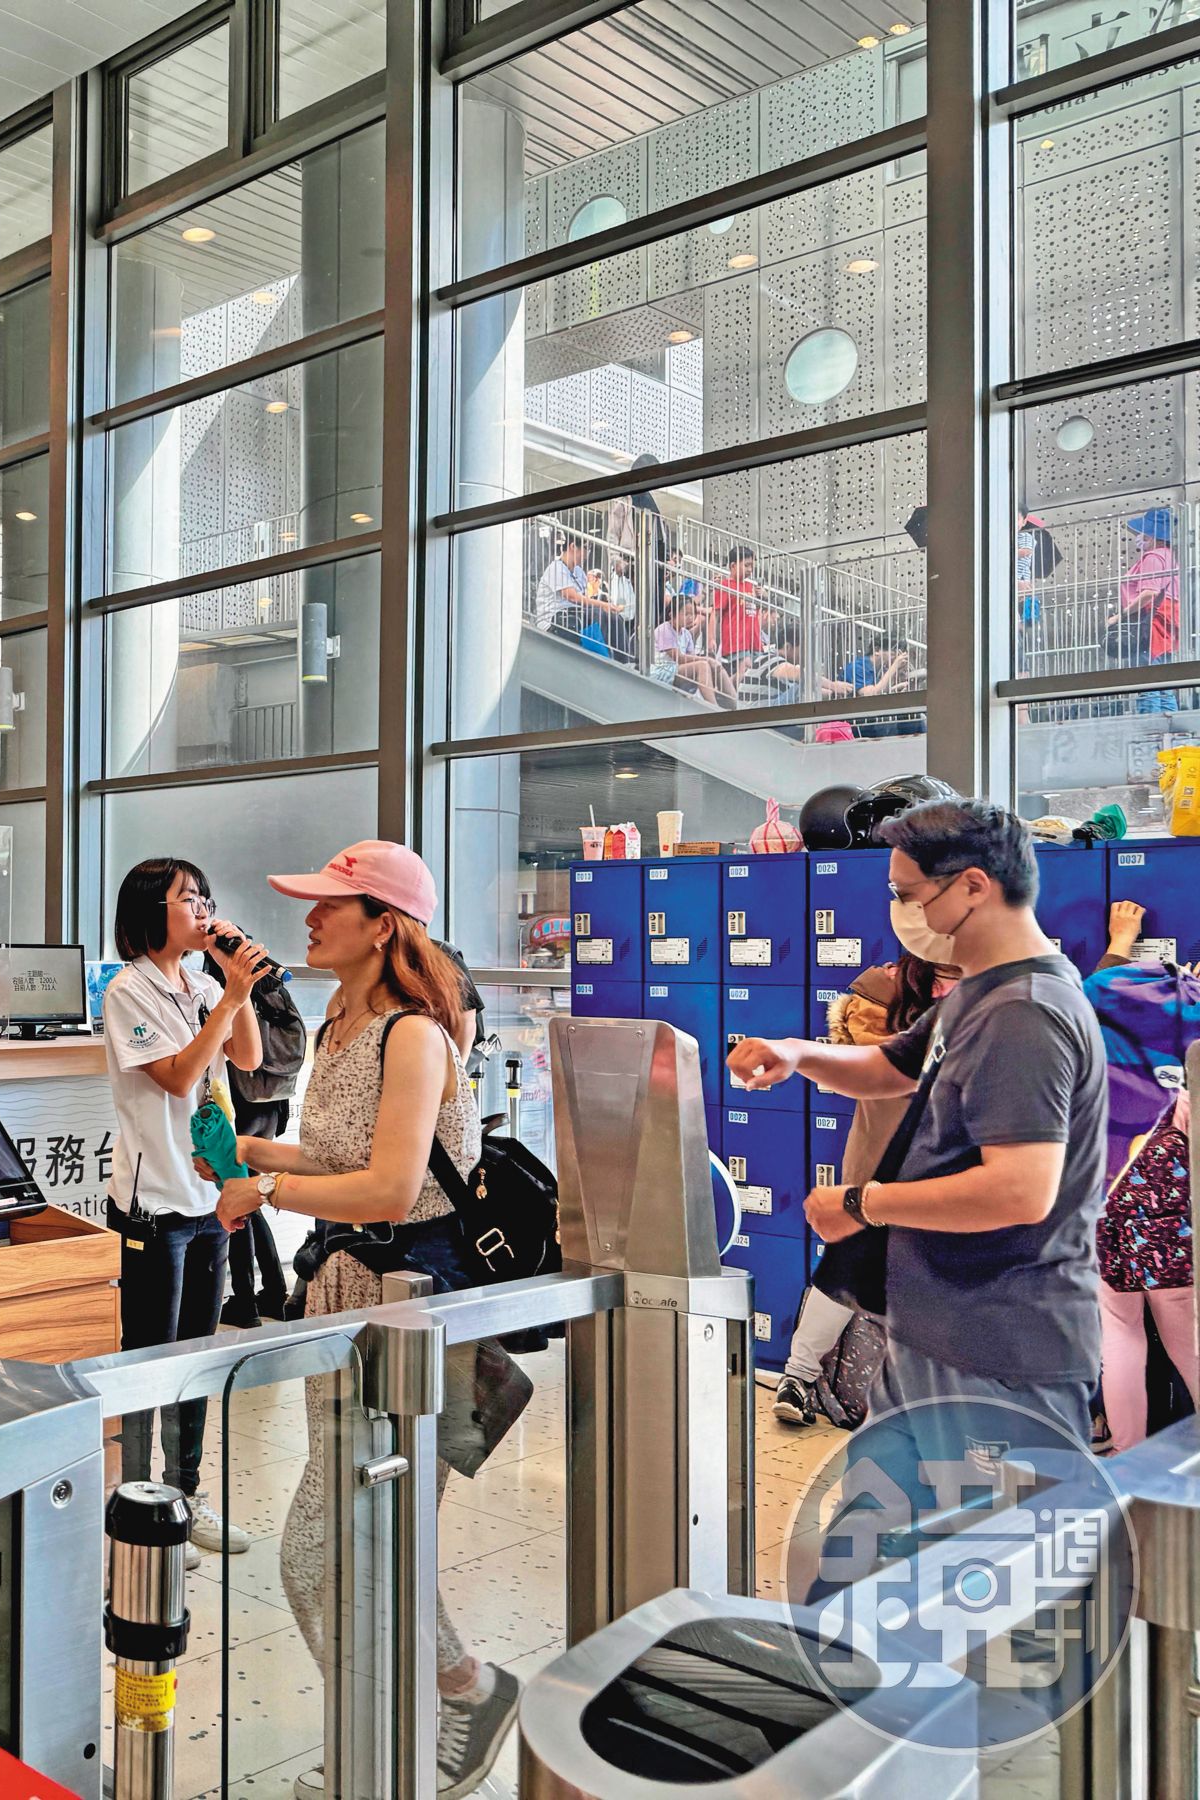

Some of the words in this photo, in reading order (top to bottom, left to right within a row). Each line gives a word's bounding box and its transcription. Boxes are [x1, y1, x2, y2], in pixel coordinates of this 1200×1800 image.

[1119, 854, 1143, 865] 0037
[817, 863, 836, 874] 0025
[729, 1112, 747, 1122] 0023
[817, 1118, 836, 1128] 0027
